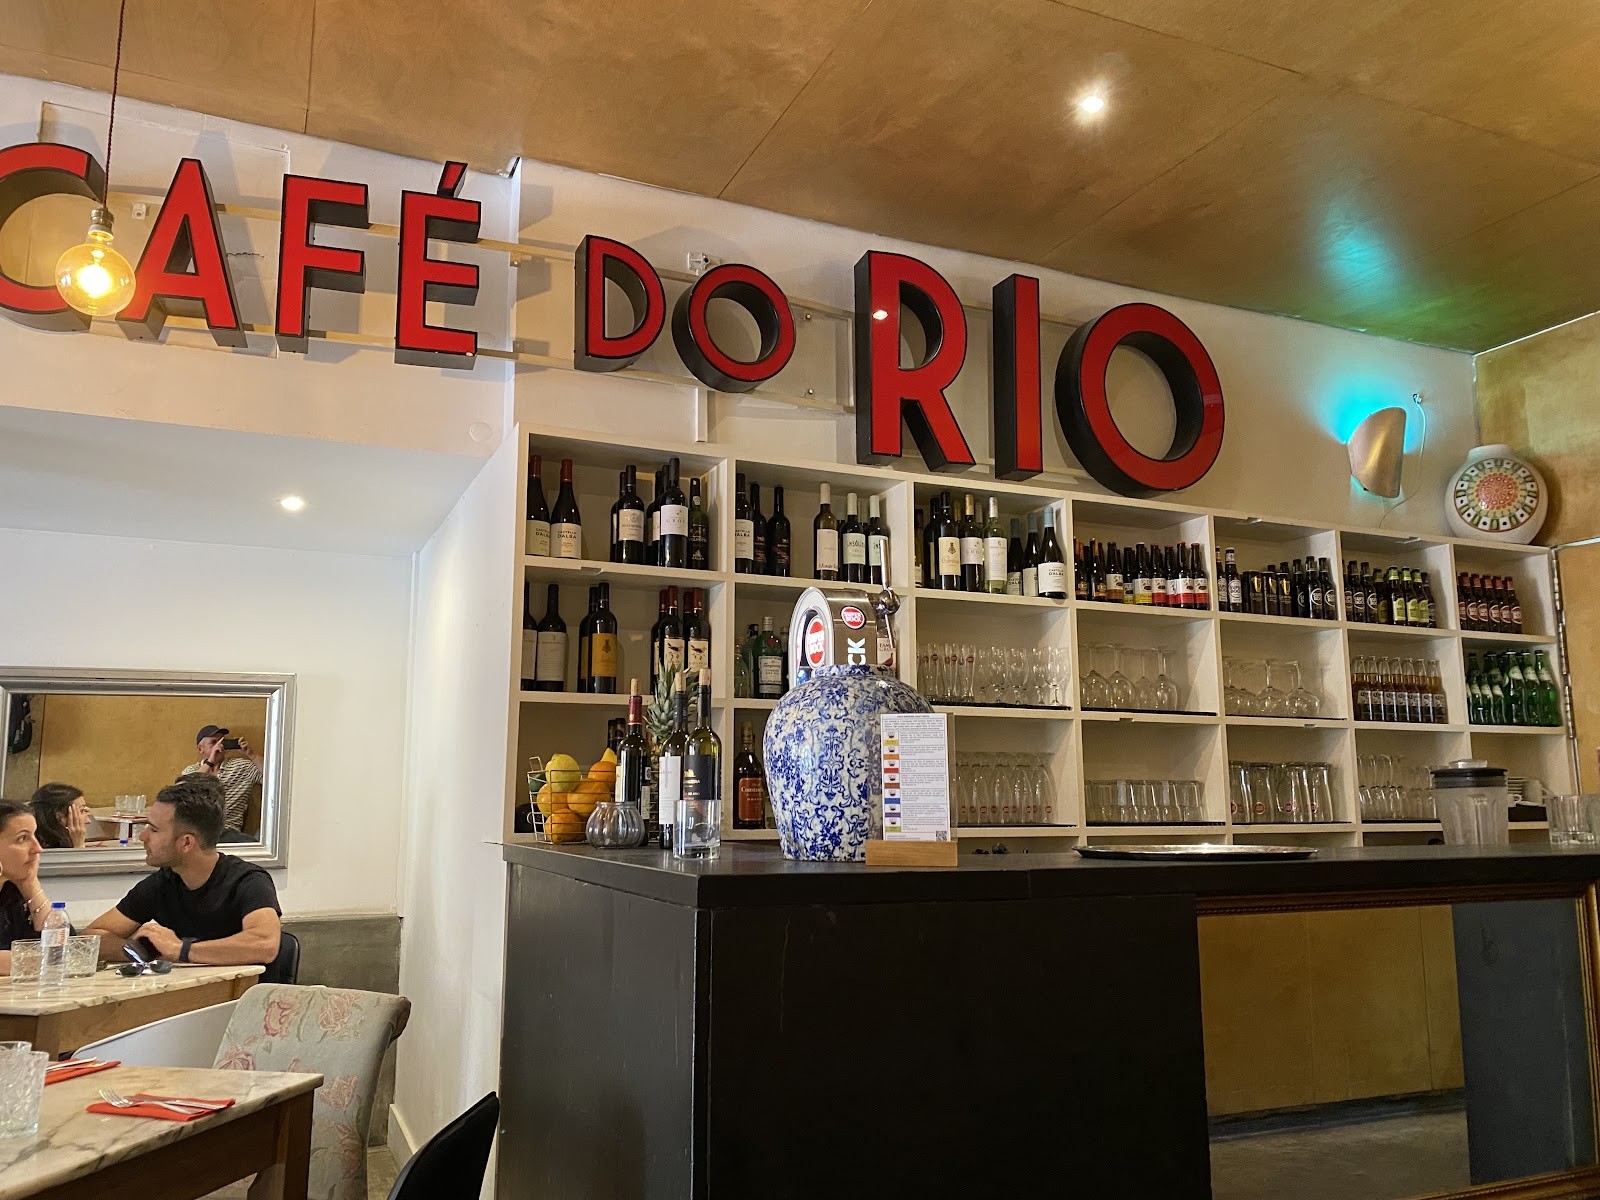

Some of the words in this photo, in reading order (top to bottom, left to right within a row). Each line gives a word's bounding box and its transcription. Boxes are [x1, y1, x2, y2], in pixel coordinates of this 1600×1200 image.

[0, 142, 482, 368] CAFÉ
[574, 234, 796, 392] DO
[854, 250, 1225, 497] RIO
